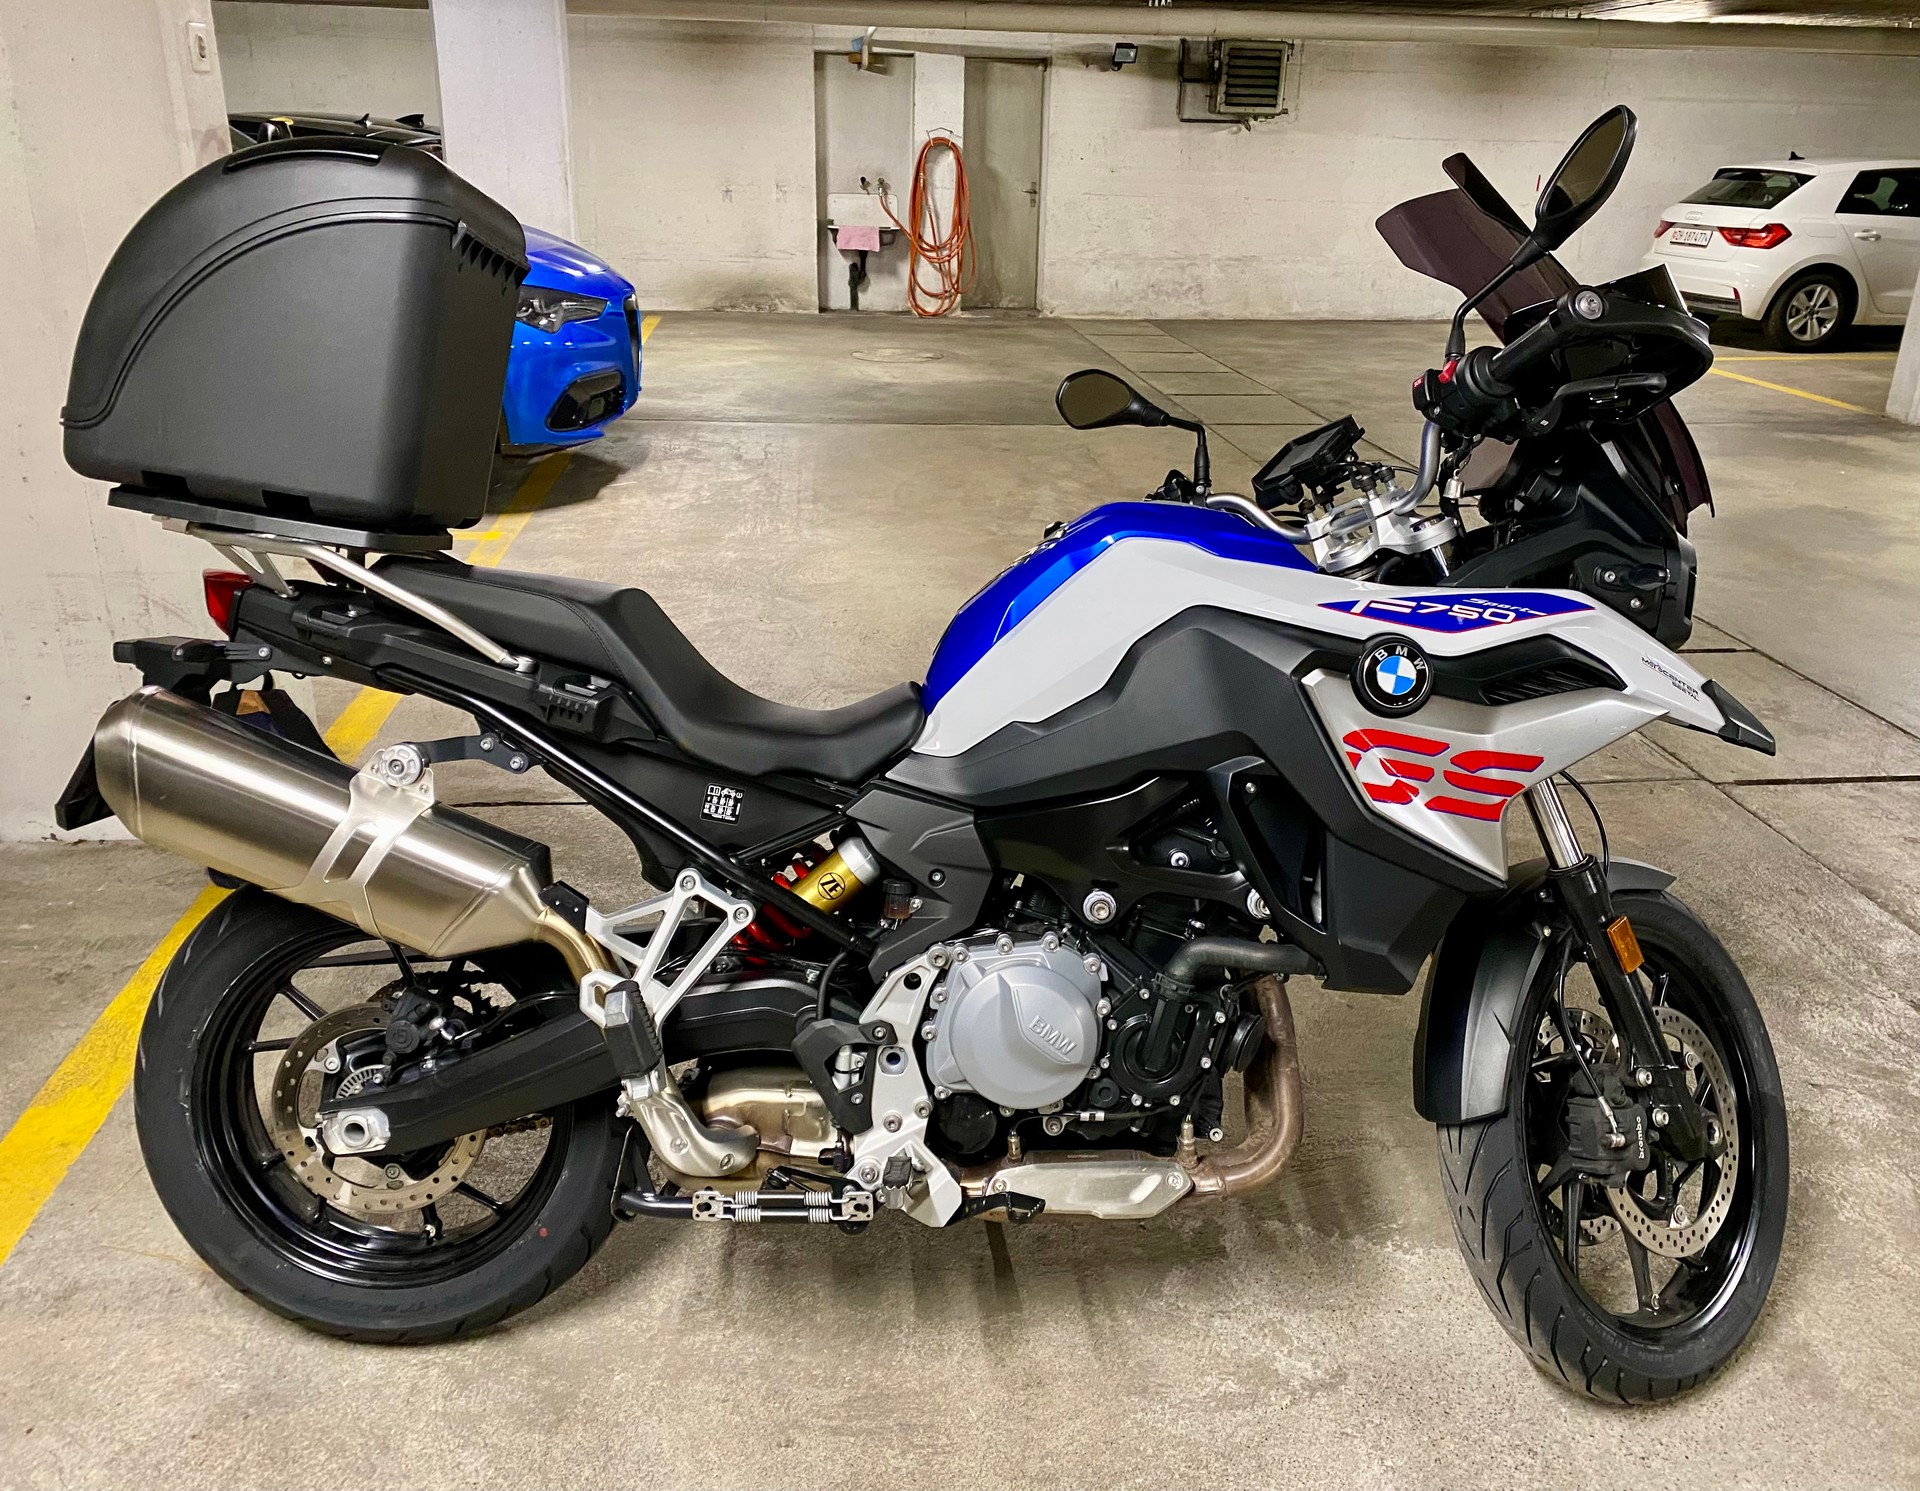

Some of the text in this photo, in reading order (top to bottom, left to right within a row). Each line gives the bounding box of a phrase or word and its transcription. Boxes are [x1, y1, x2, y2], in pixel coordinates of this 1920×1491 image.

[1350, 599, 1517, 624] F750
[1462, 597, 1548, 616] Sport
[1375, 645, 1426, 670] BMW
[1343, 728, 1544, 822] GS
[1029, 1015, 1077, 1055] BMW
[1636, 1116, 1645, 1159] brembo
